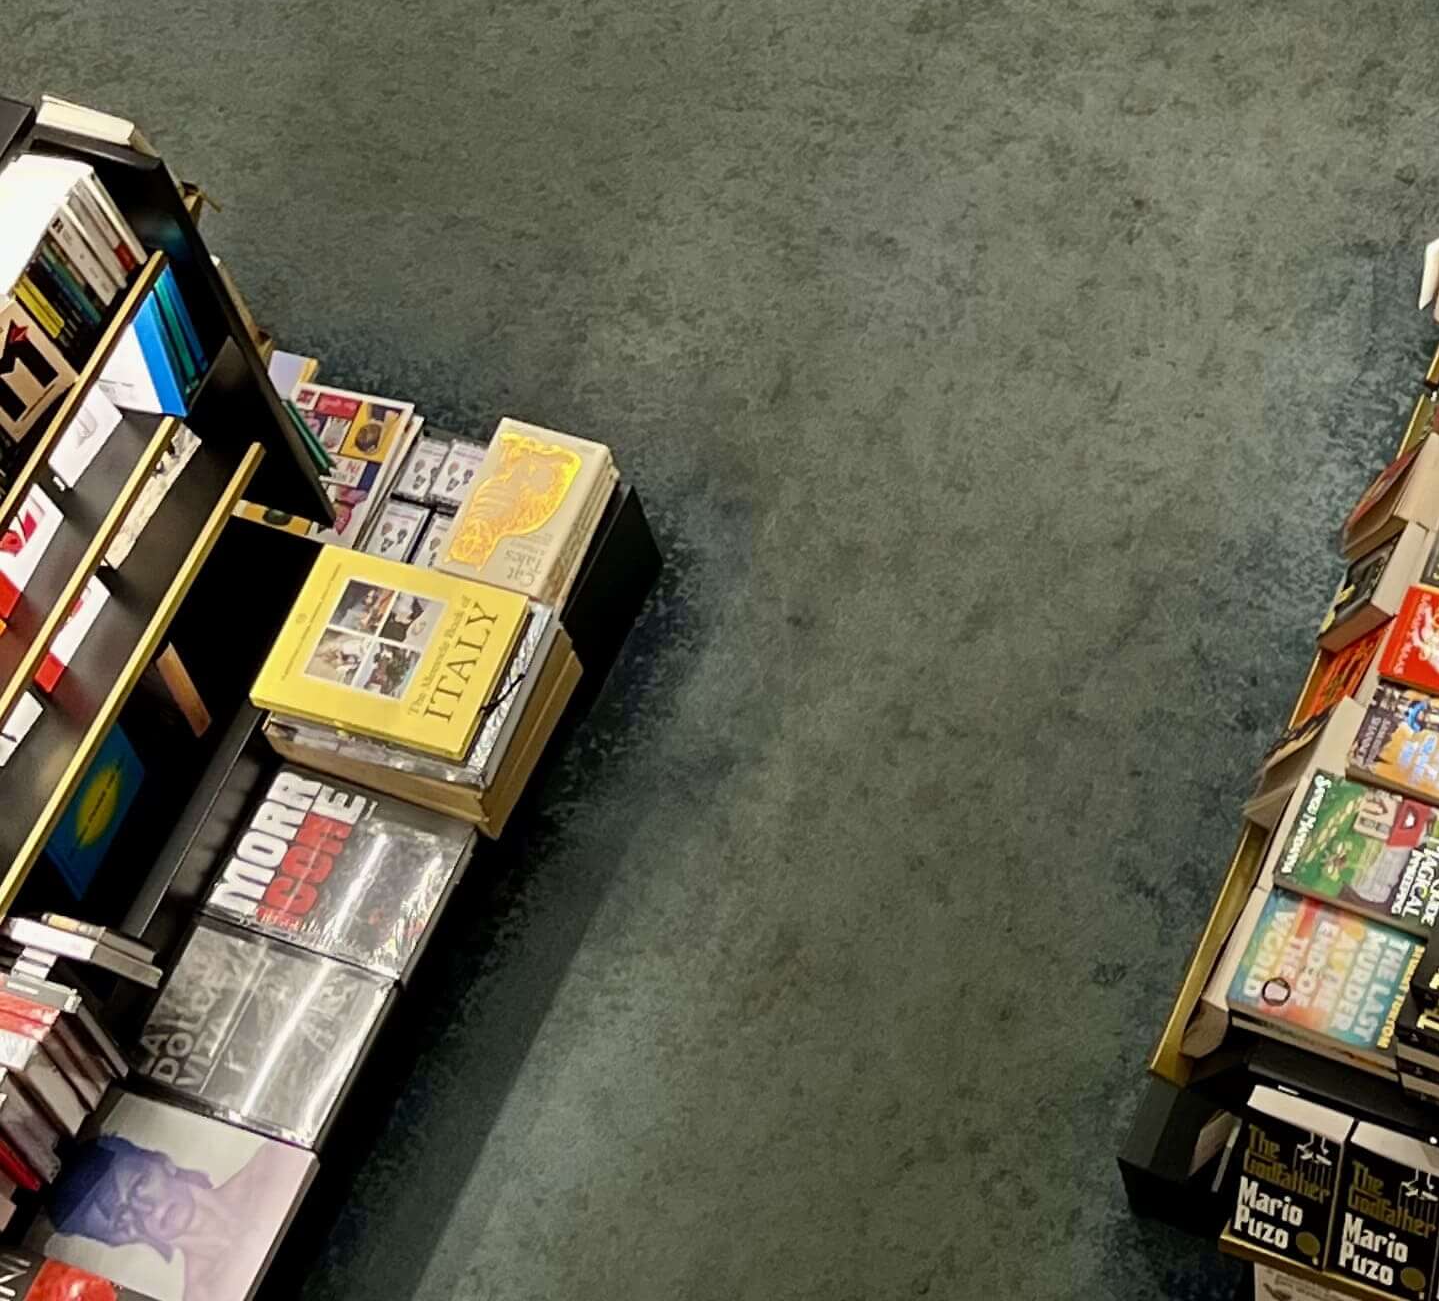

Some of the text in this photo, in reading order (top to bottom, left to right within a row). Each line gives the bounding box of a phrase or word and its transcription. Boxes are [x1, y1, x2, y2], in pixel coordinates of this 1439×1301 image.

[417, 600, 505, 727] ITALY
[213, 762, 321, 921] MORR
[254, 776, 368, 941] ICONE
[1330, 929, 1384, 1033] MURDER
[1351, 937, 1409, 1042] THE LAST
[1249, 1124, 1281, 1157] The
[1240, 1175, 1304, 1227] Mario
[1244, 1148, 1332, 1205] Godfather
[1352, 1160, 1385, 1195] The
[1234, 1205, 1290, 1251] Puzo
[1344, 1213, 1409, 1265] Mario
[1348, 1185, 1438, 1240] Godfather
[1339, 1242, 1395, 1287] Puzo
